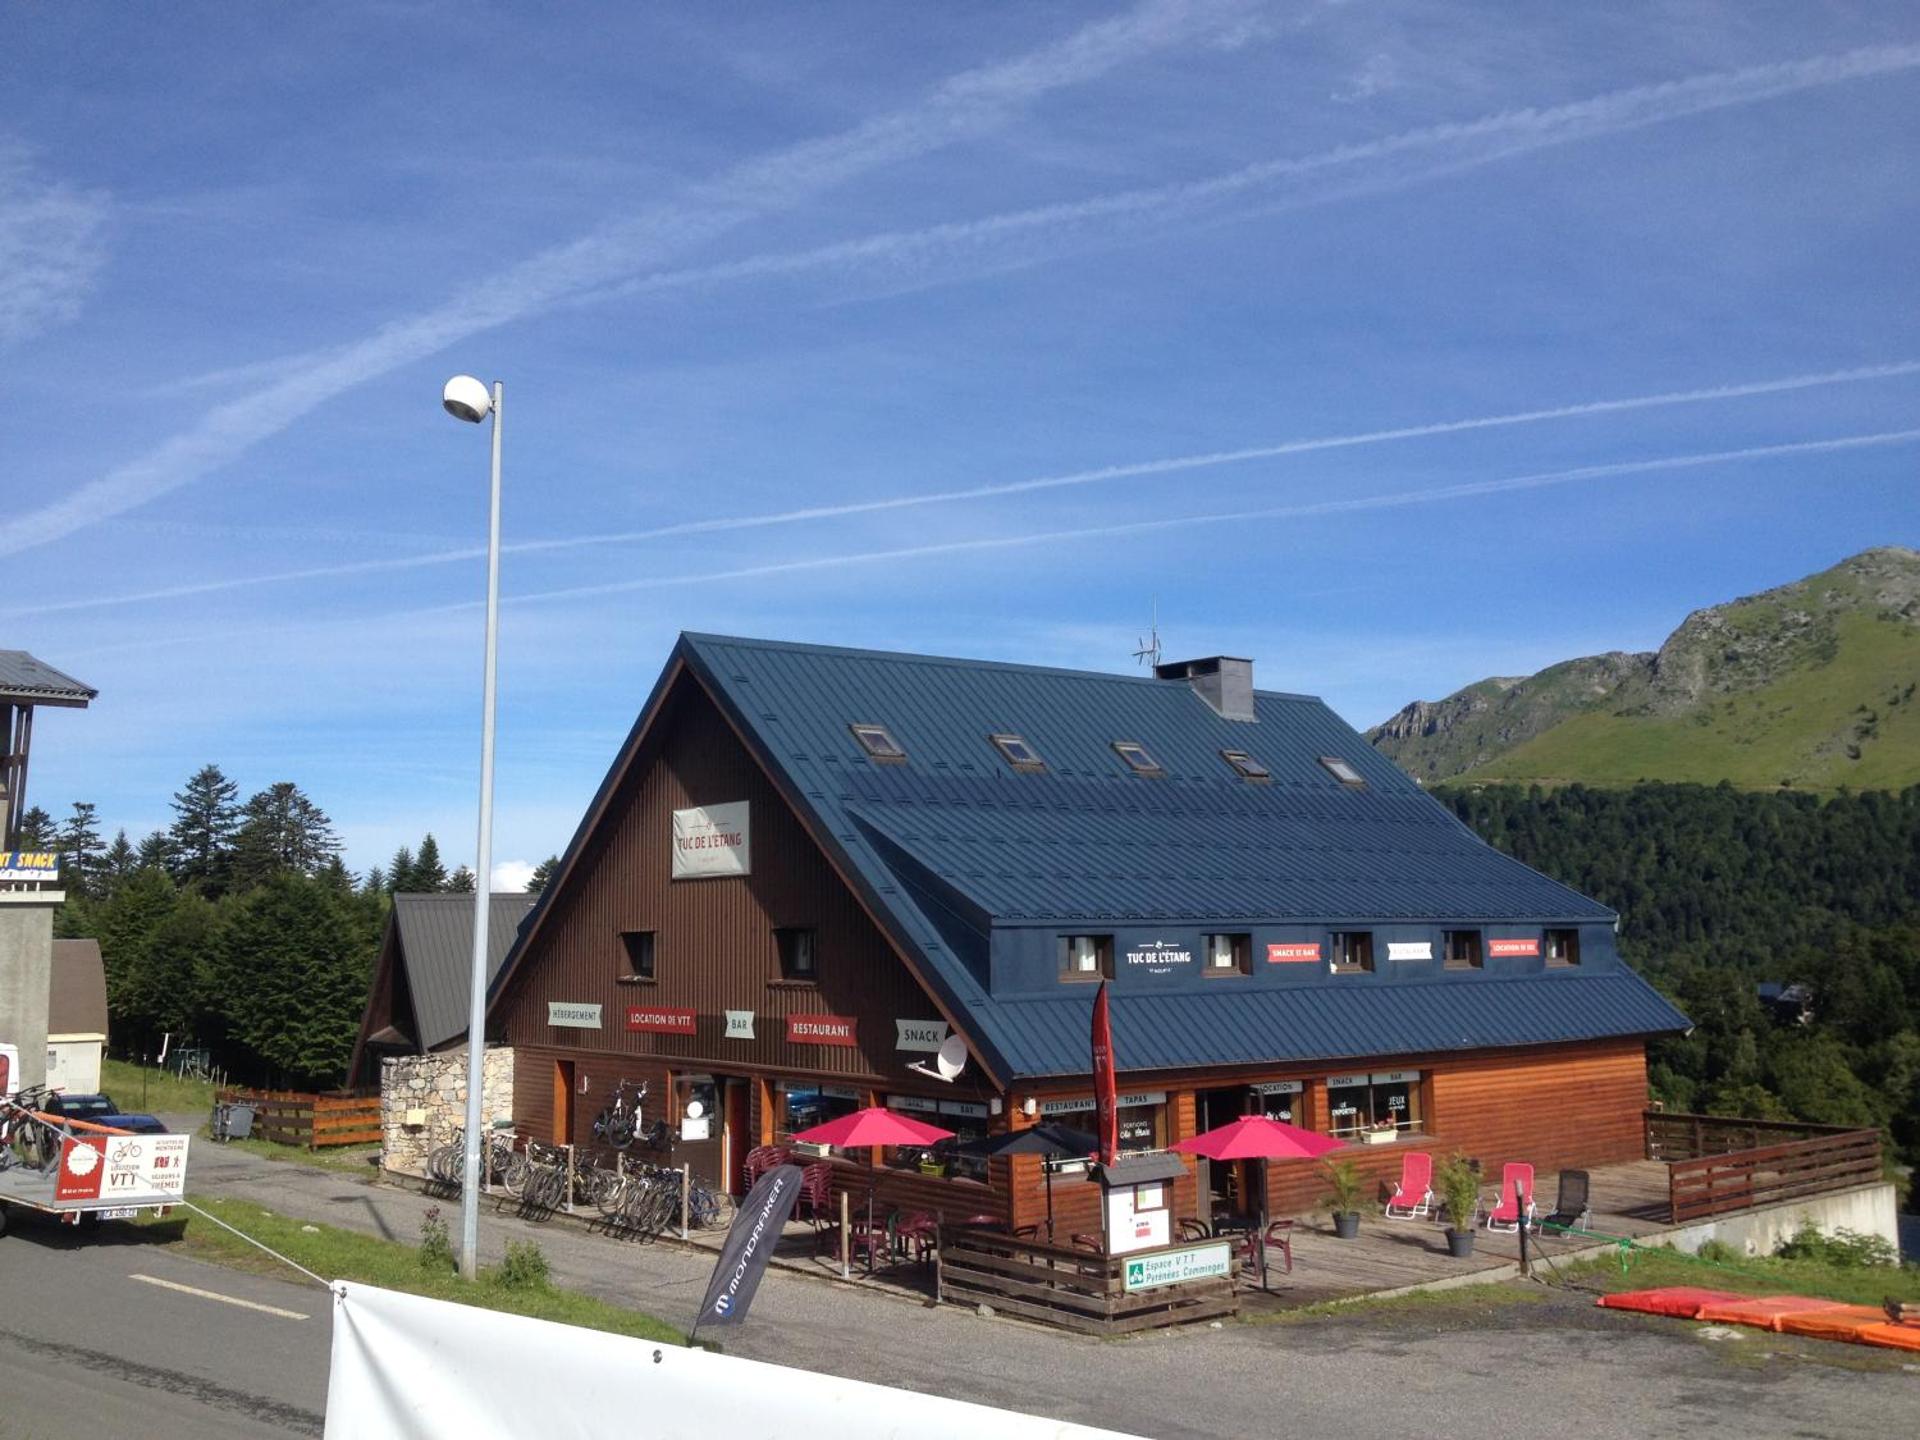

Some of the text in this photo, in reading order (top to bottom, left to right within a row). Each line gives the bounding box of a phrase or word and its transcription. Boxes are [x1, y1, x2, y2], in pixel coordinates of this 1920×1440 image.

[695, 836, 706, 849] DE
[17, 853, 56, 868] SNACK
[1127, 949, 1191, 964] TUC DE L'ÉTANG
[631, 1013, 667, 1025] LOCATION
[678, 1015, 691, 1026] VTT
[731, 1018, 747, 1030] BAR
[793, 1023, 849, 1037] RESTAURANT
[904, 1029, 939, 1043] SNACK
[1124, 1095, 1148, 1104] TAPAS
[1388, 1096, 1405, 1105] JEUX
[110, 1173, 136, 1186] VTT
[1146, 1260, 1172, 1272] Espace
[1183, 1262, 1225, 1276] Comminges
